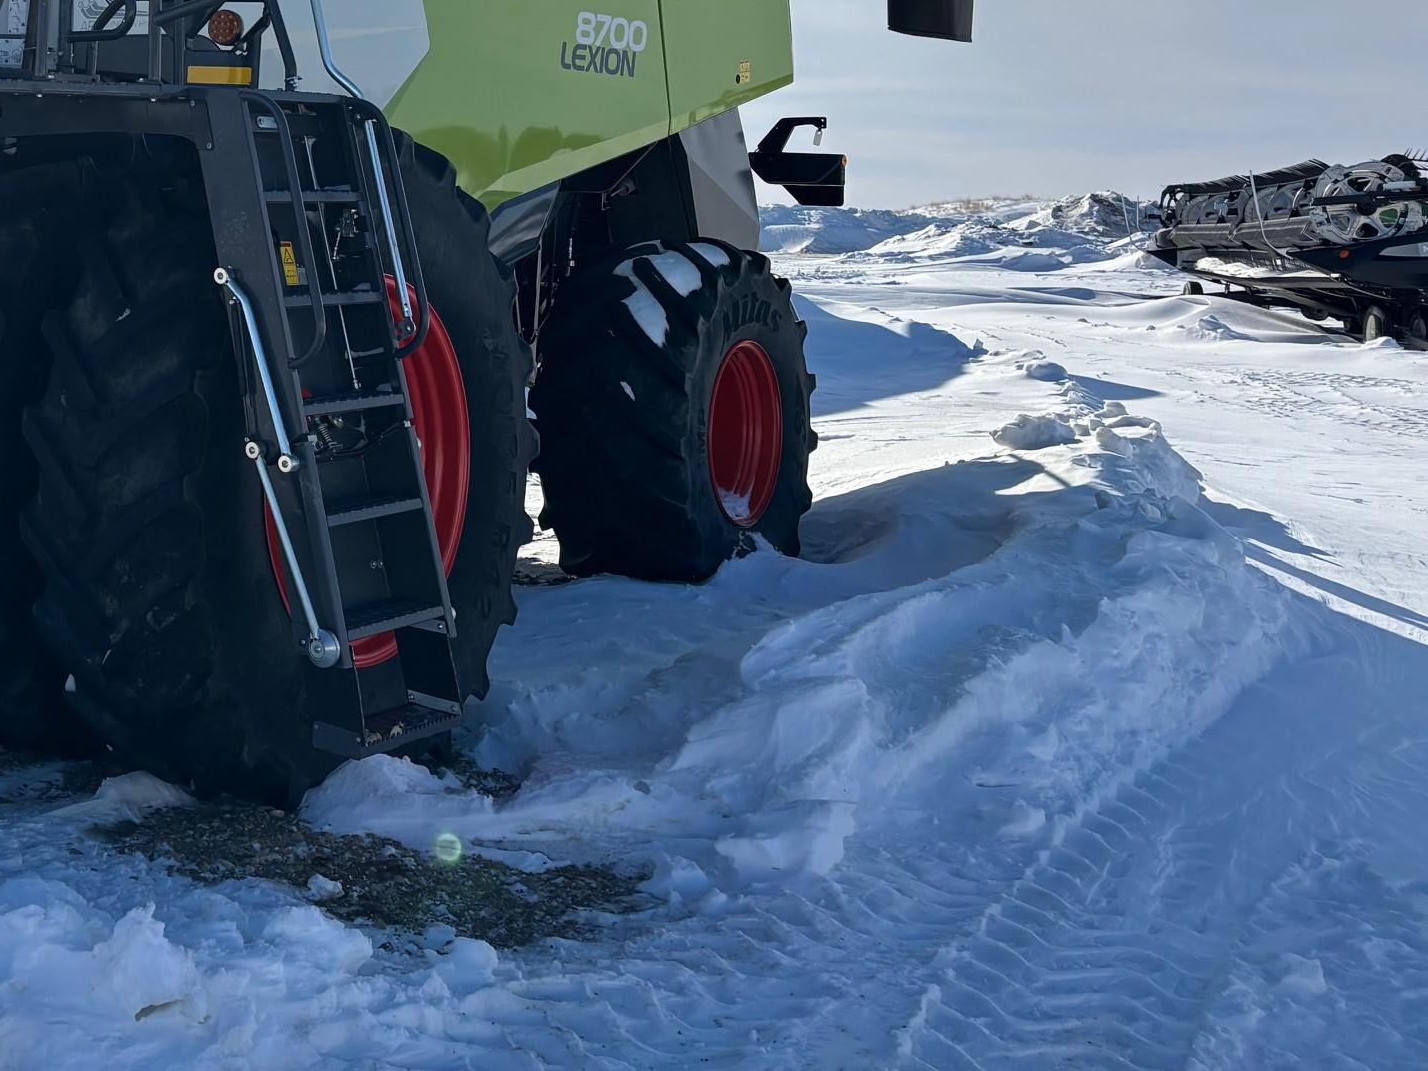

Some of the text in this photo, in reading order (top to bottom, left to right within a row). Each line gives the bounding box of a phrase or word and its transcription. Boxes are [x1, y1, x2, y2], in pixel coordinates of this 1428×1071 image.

[575, 11, 648, 52] 8700
[560, 41, 637, 78] LEXION
[722, 291, 784, 342] Mitas
